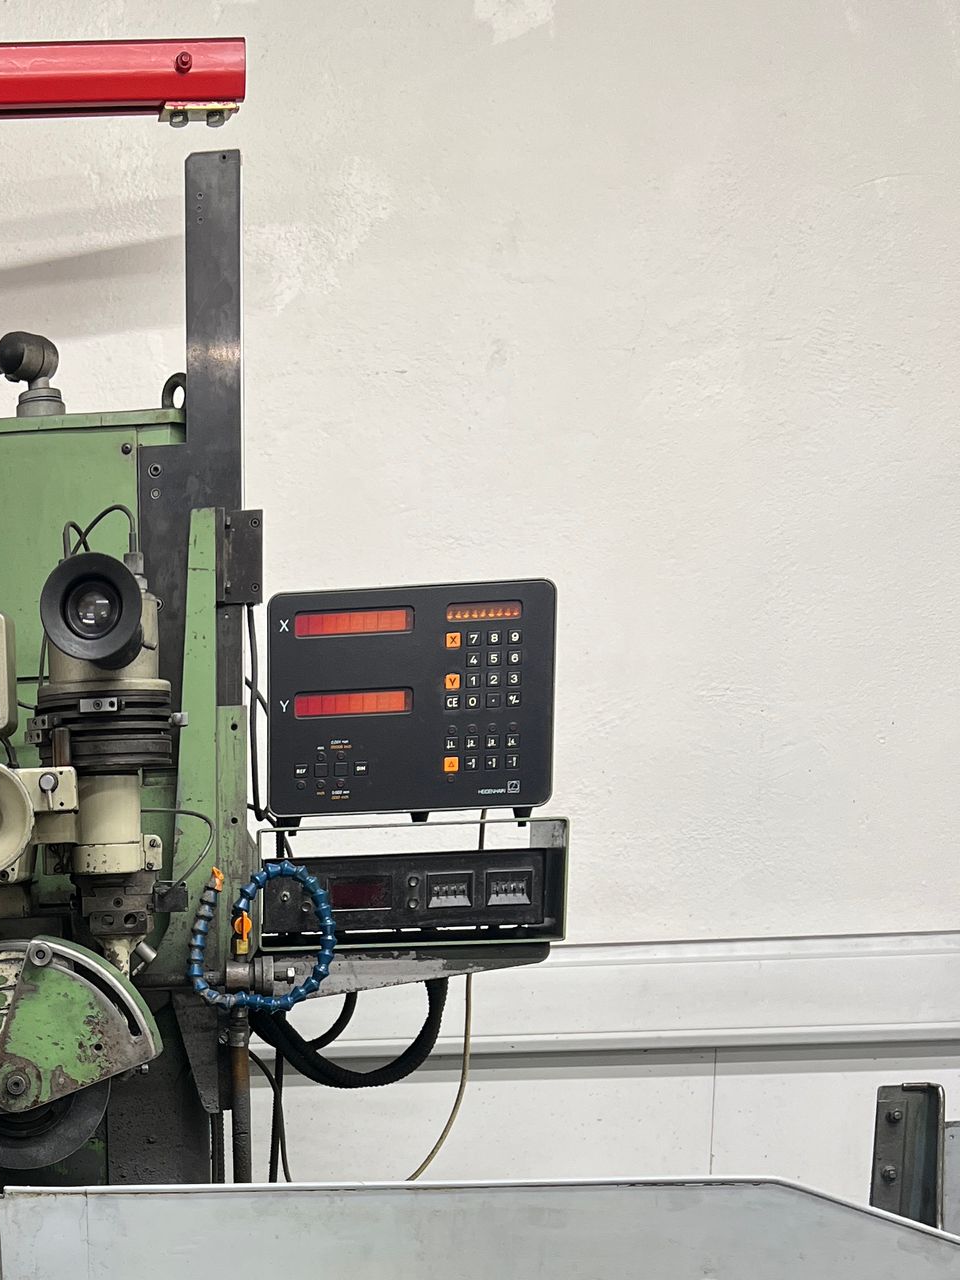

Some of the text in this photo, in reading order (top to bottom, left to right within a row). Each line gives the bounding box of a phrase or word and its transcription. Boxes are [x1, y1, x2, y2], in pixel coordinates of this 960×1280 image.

[279, 619, 289, 633] X
[450, 632, 519, 645] X 7 8 9
[469, 653, 519, 664] 4 5 6
[449, 674, 518, 686] Y 1 2 3
[279, 700, 289, 713] Y
[447, 697, 458, 708] CE
